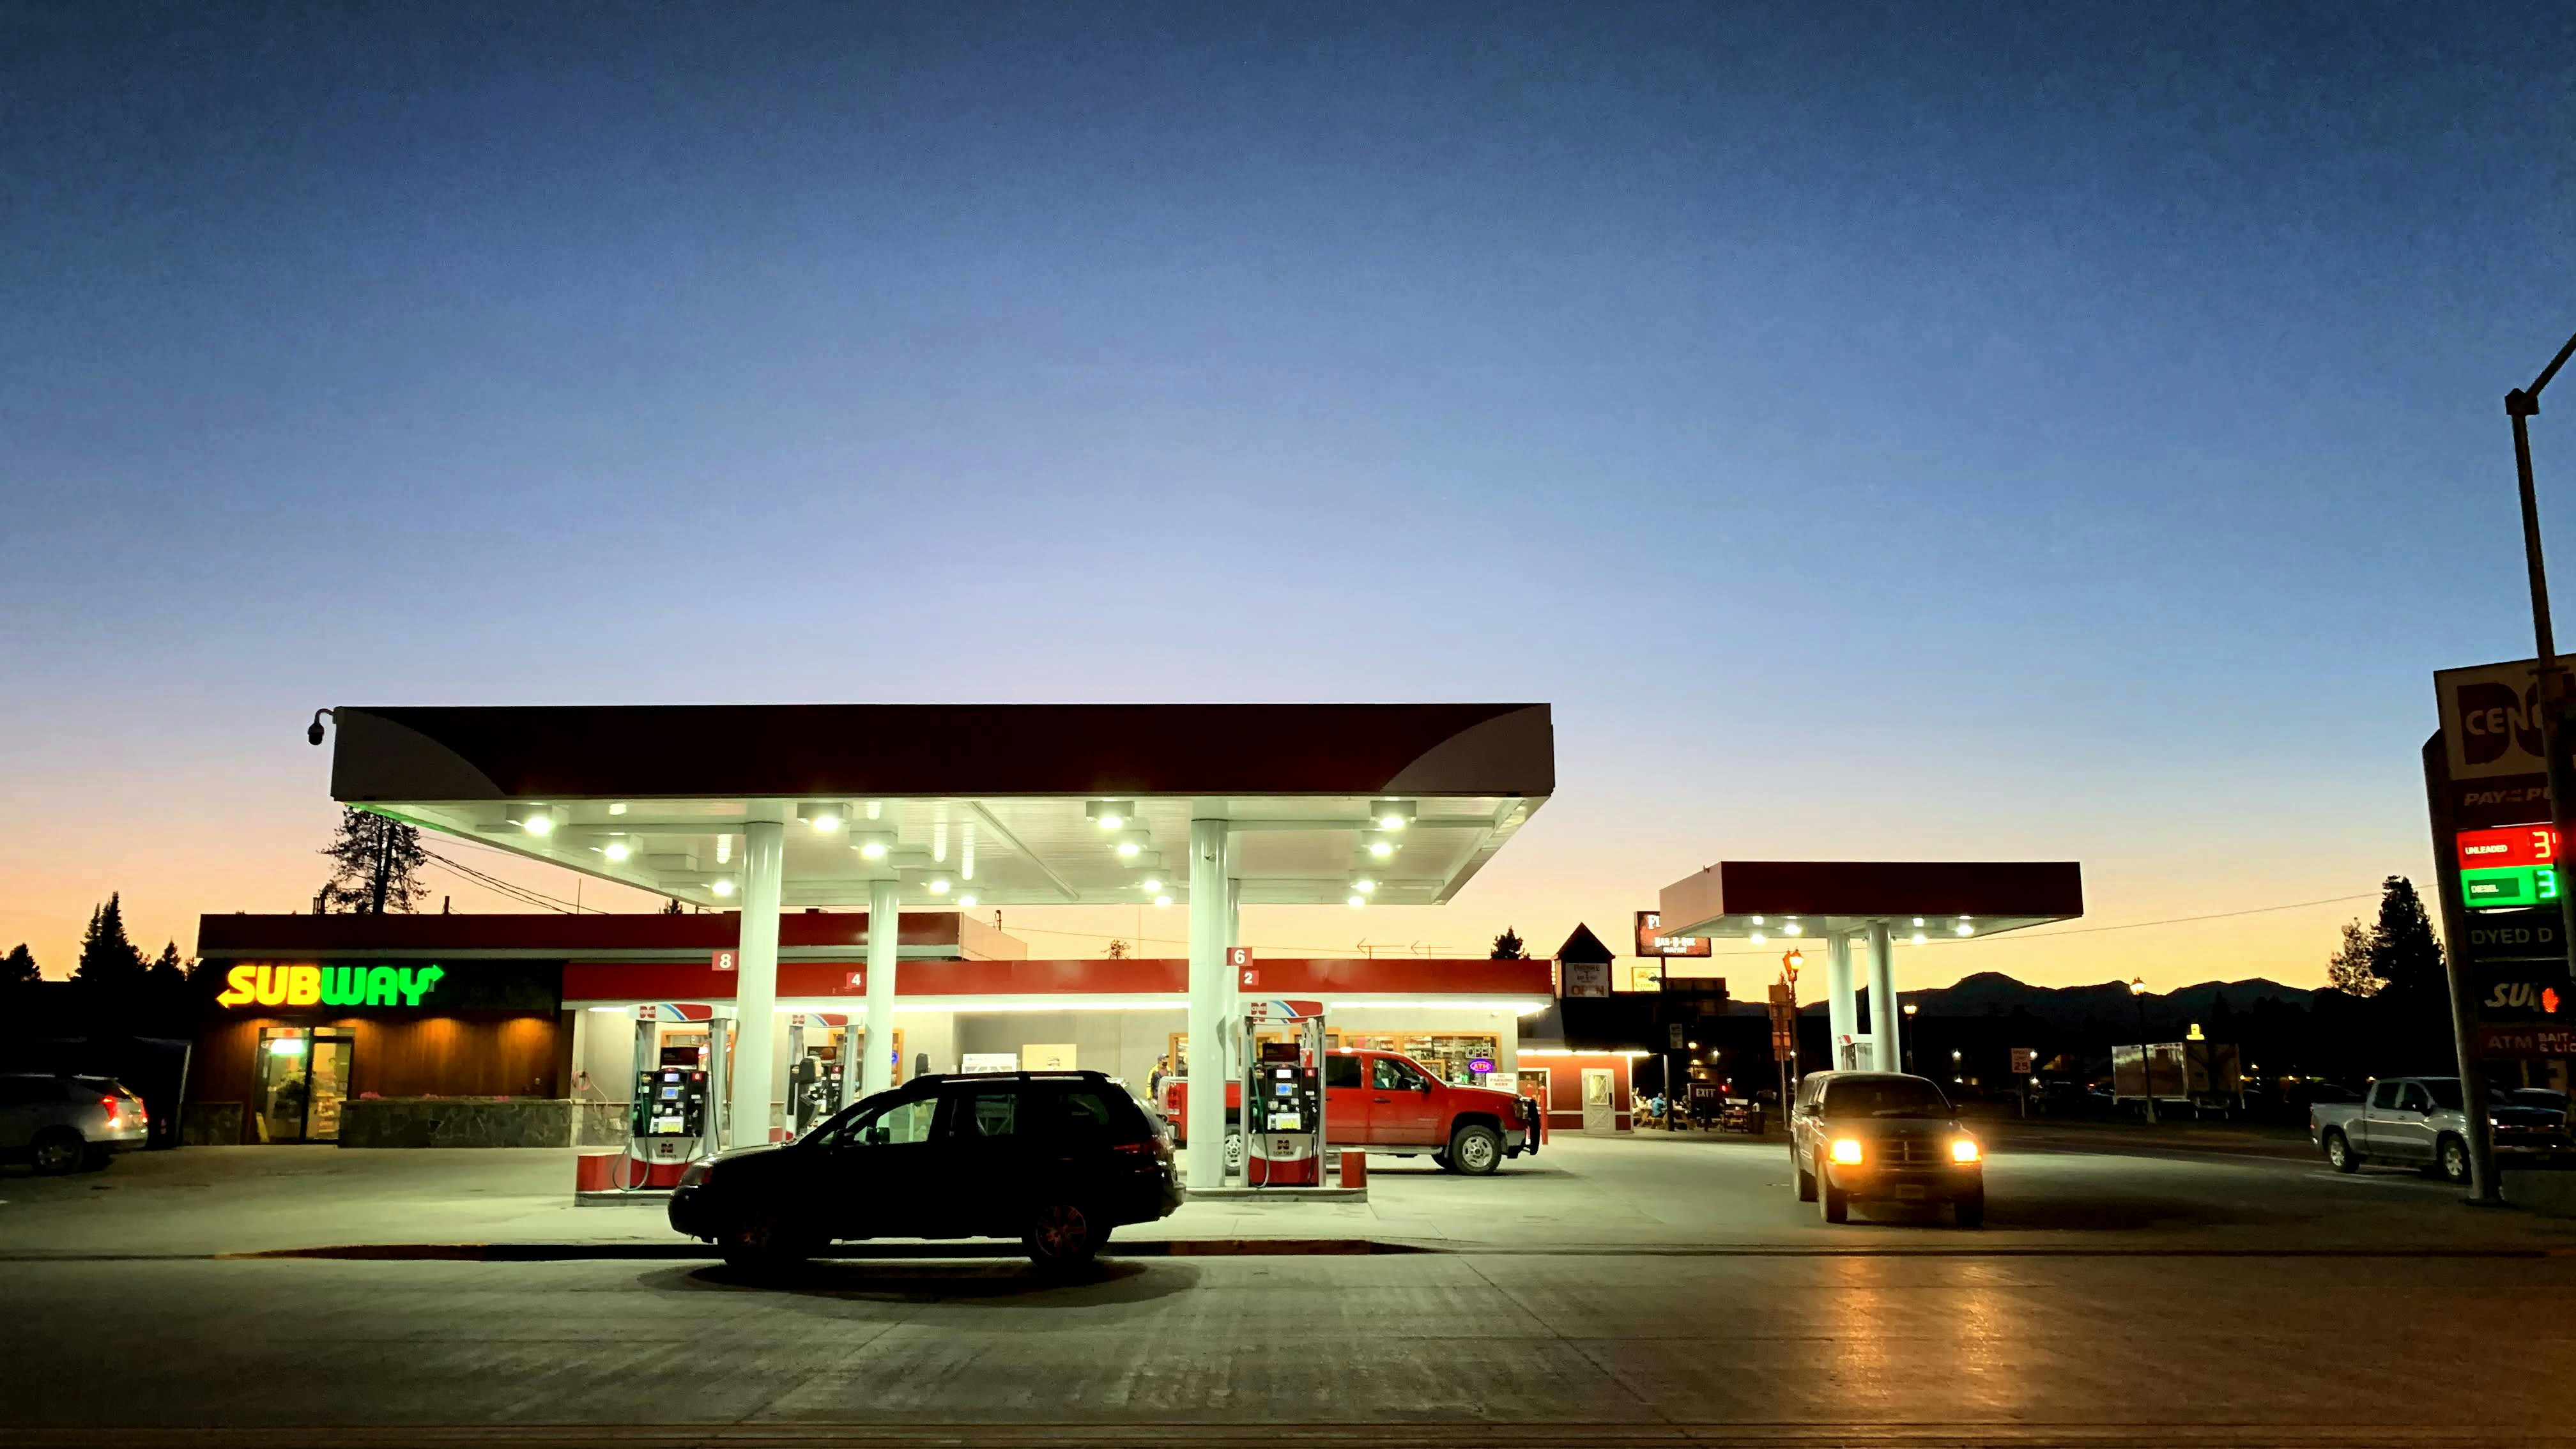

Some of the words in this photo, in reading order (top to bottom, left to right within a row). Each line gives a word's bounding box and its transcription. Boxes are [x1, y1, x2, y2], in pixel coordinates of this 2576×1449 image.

[2464, 790, 2507, 806] PAY
[2465, 844, 2508, 855] UNLEADED
[2471, 884, 2499, 893] DIESEL
[2471, 928, 2530, 944] DYED
[719, 953, 732, 969] 8
[1234, 949, 1245, 964] 6
[851, 974, 861, 985] 4
[1244, 972, 1253, 984] 2
[215, 965, 444, 1009] SUBWAY
[1572, 986, 1605, 996] OPN
[2488, 1036, 2533, 1048] ATM
[2538, 1033, 2569, 1042] BAIT
[1468, 1047, 1496, 1058] OPEN
[2014, 1062, 2028, 1070] 25
[1696, 1088, 1716, 1098] EXIT
